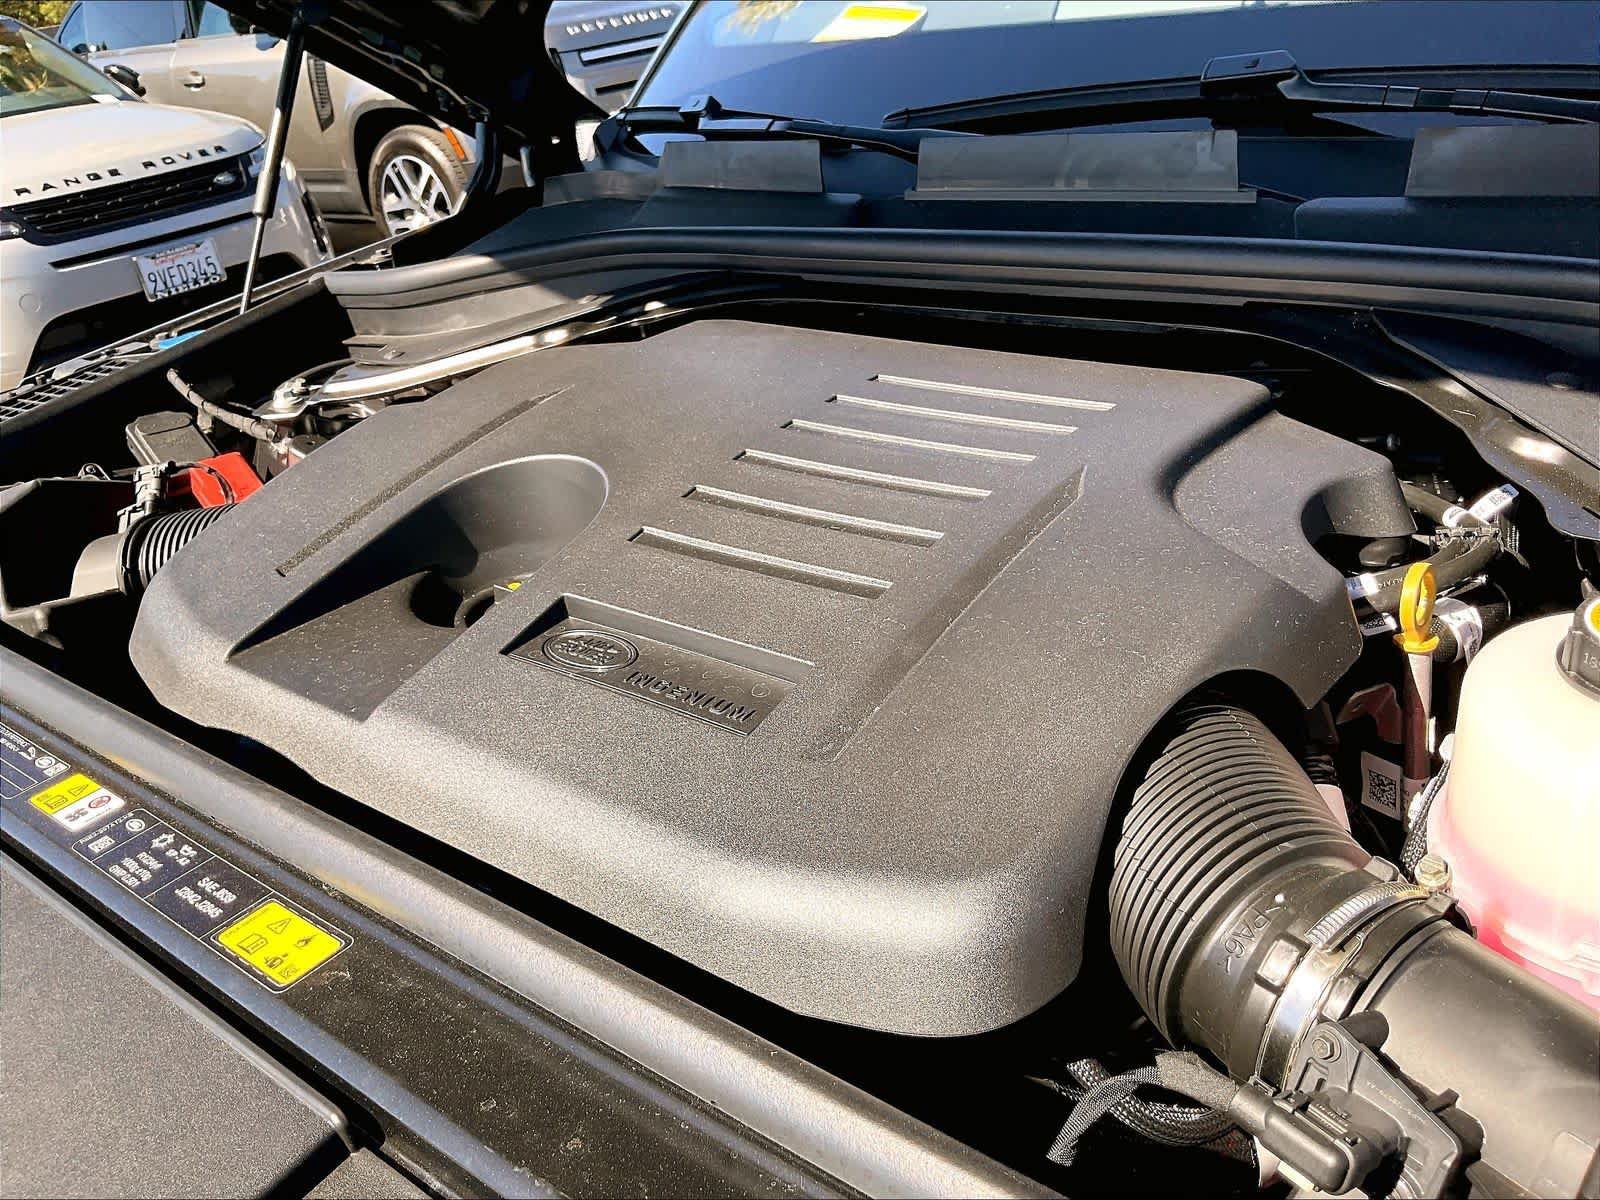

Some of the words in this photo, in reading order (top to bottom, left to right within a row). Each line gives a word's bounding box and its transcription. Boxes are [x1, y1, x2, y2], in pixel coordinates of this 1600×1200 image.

[566, 8, 673, 36] DEFENDER
[14, 168, 123, 197] RANGE
[142, 145, 228, 170] ROVER
[624, 671, 756, 723] INGENIUM
